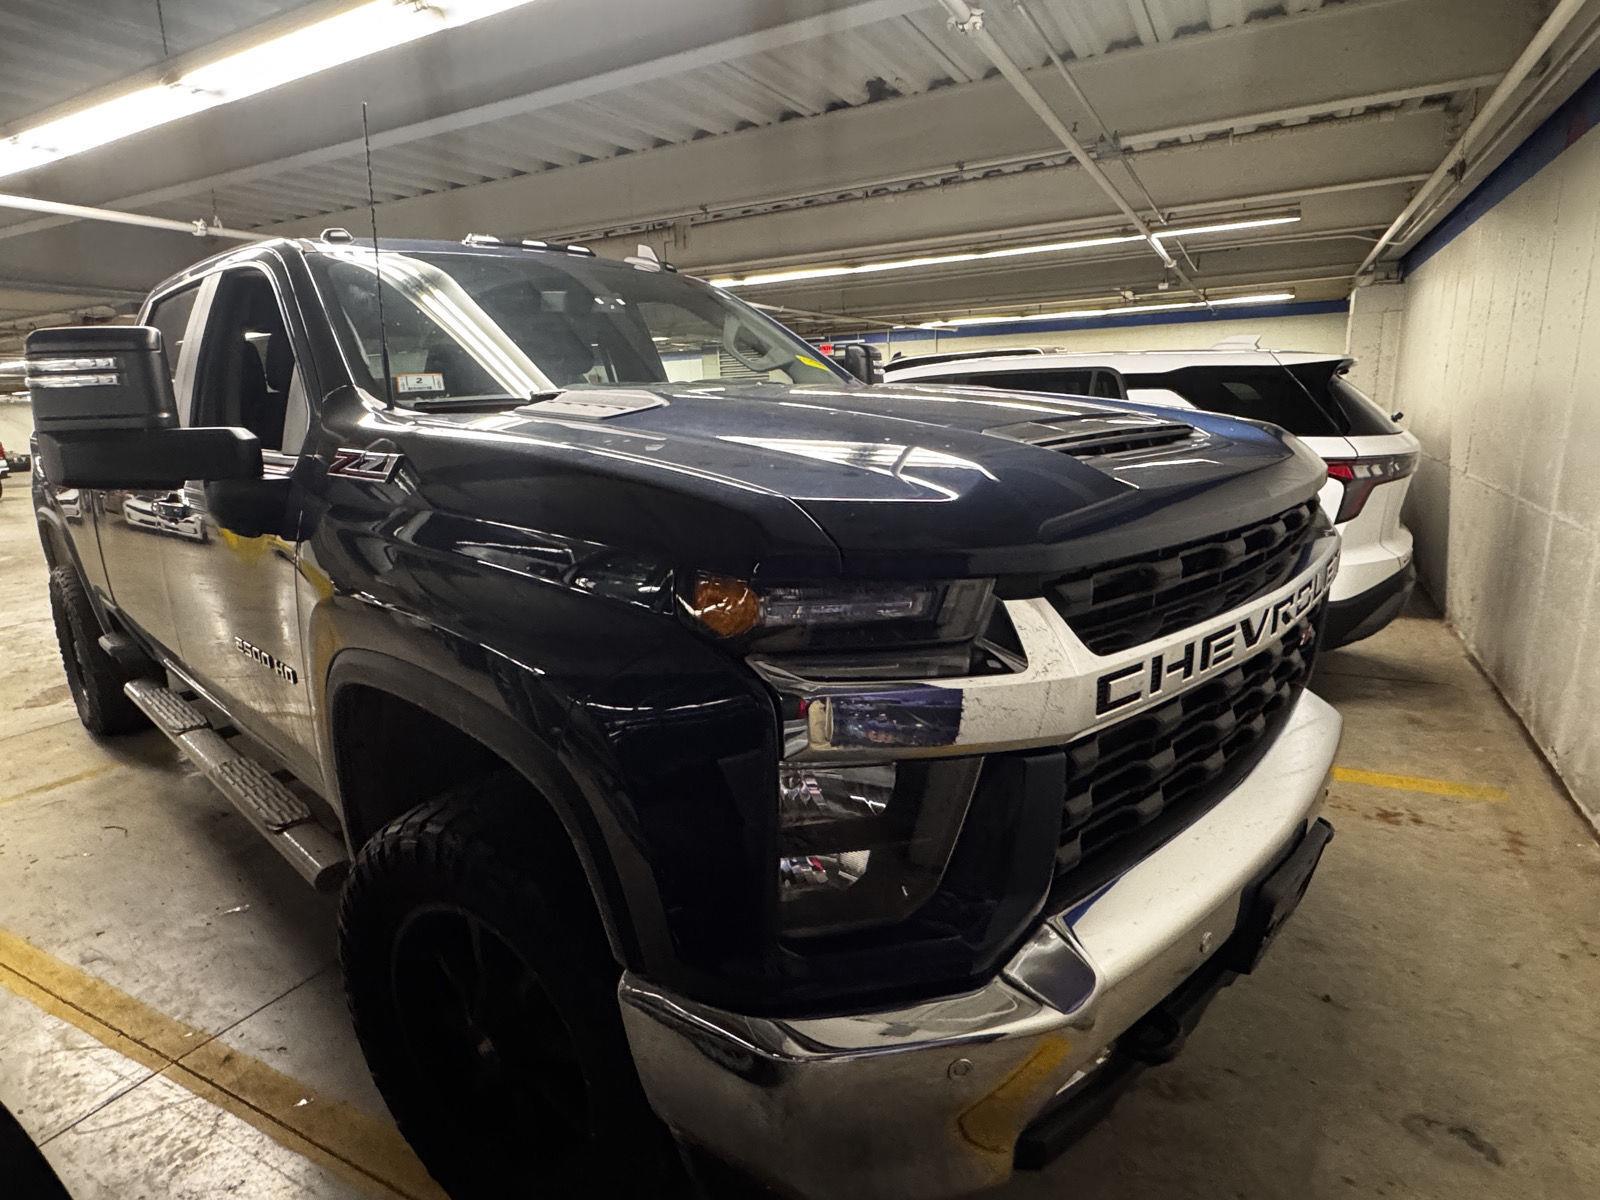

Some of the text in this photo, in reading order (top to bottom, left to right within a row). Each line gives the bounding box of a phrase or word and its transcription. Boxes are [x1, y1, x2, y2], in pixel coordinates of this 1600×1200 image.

[326, 447, 402, 483] Z71
[1096, 552, 1339, 719] CHEVROLE
[234, 636, 298, 686] 2500 HD
